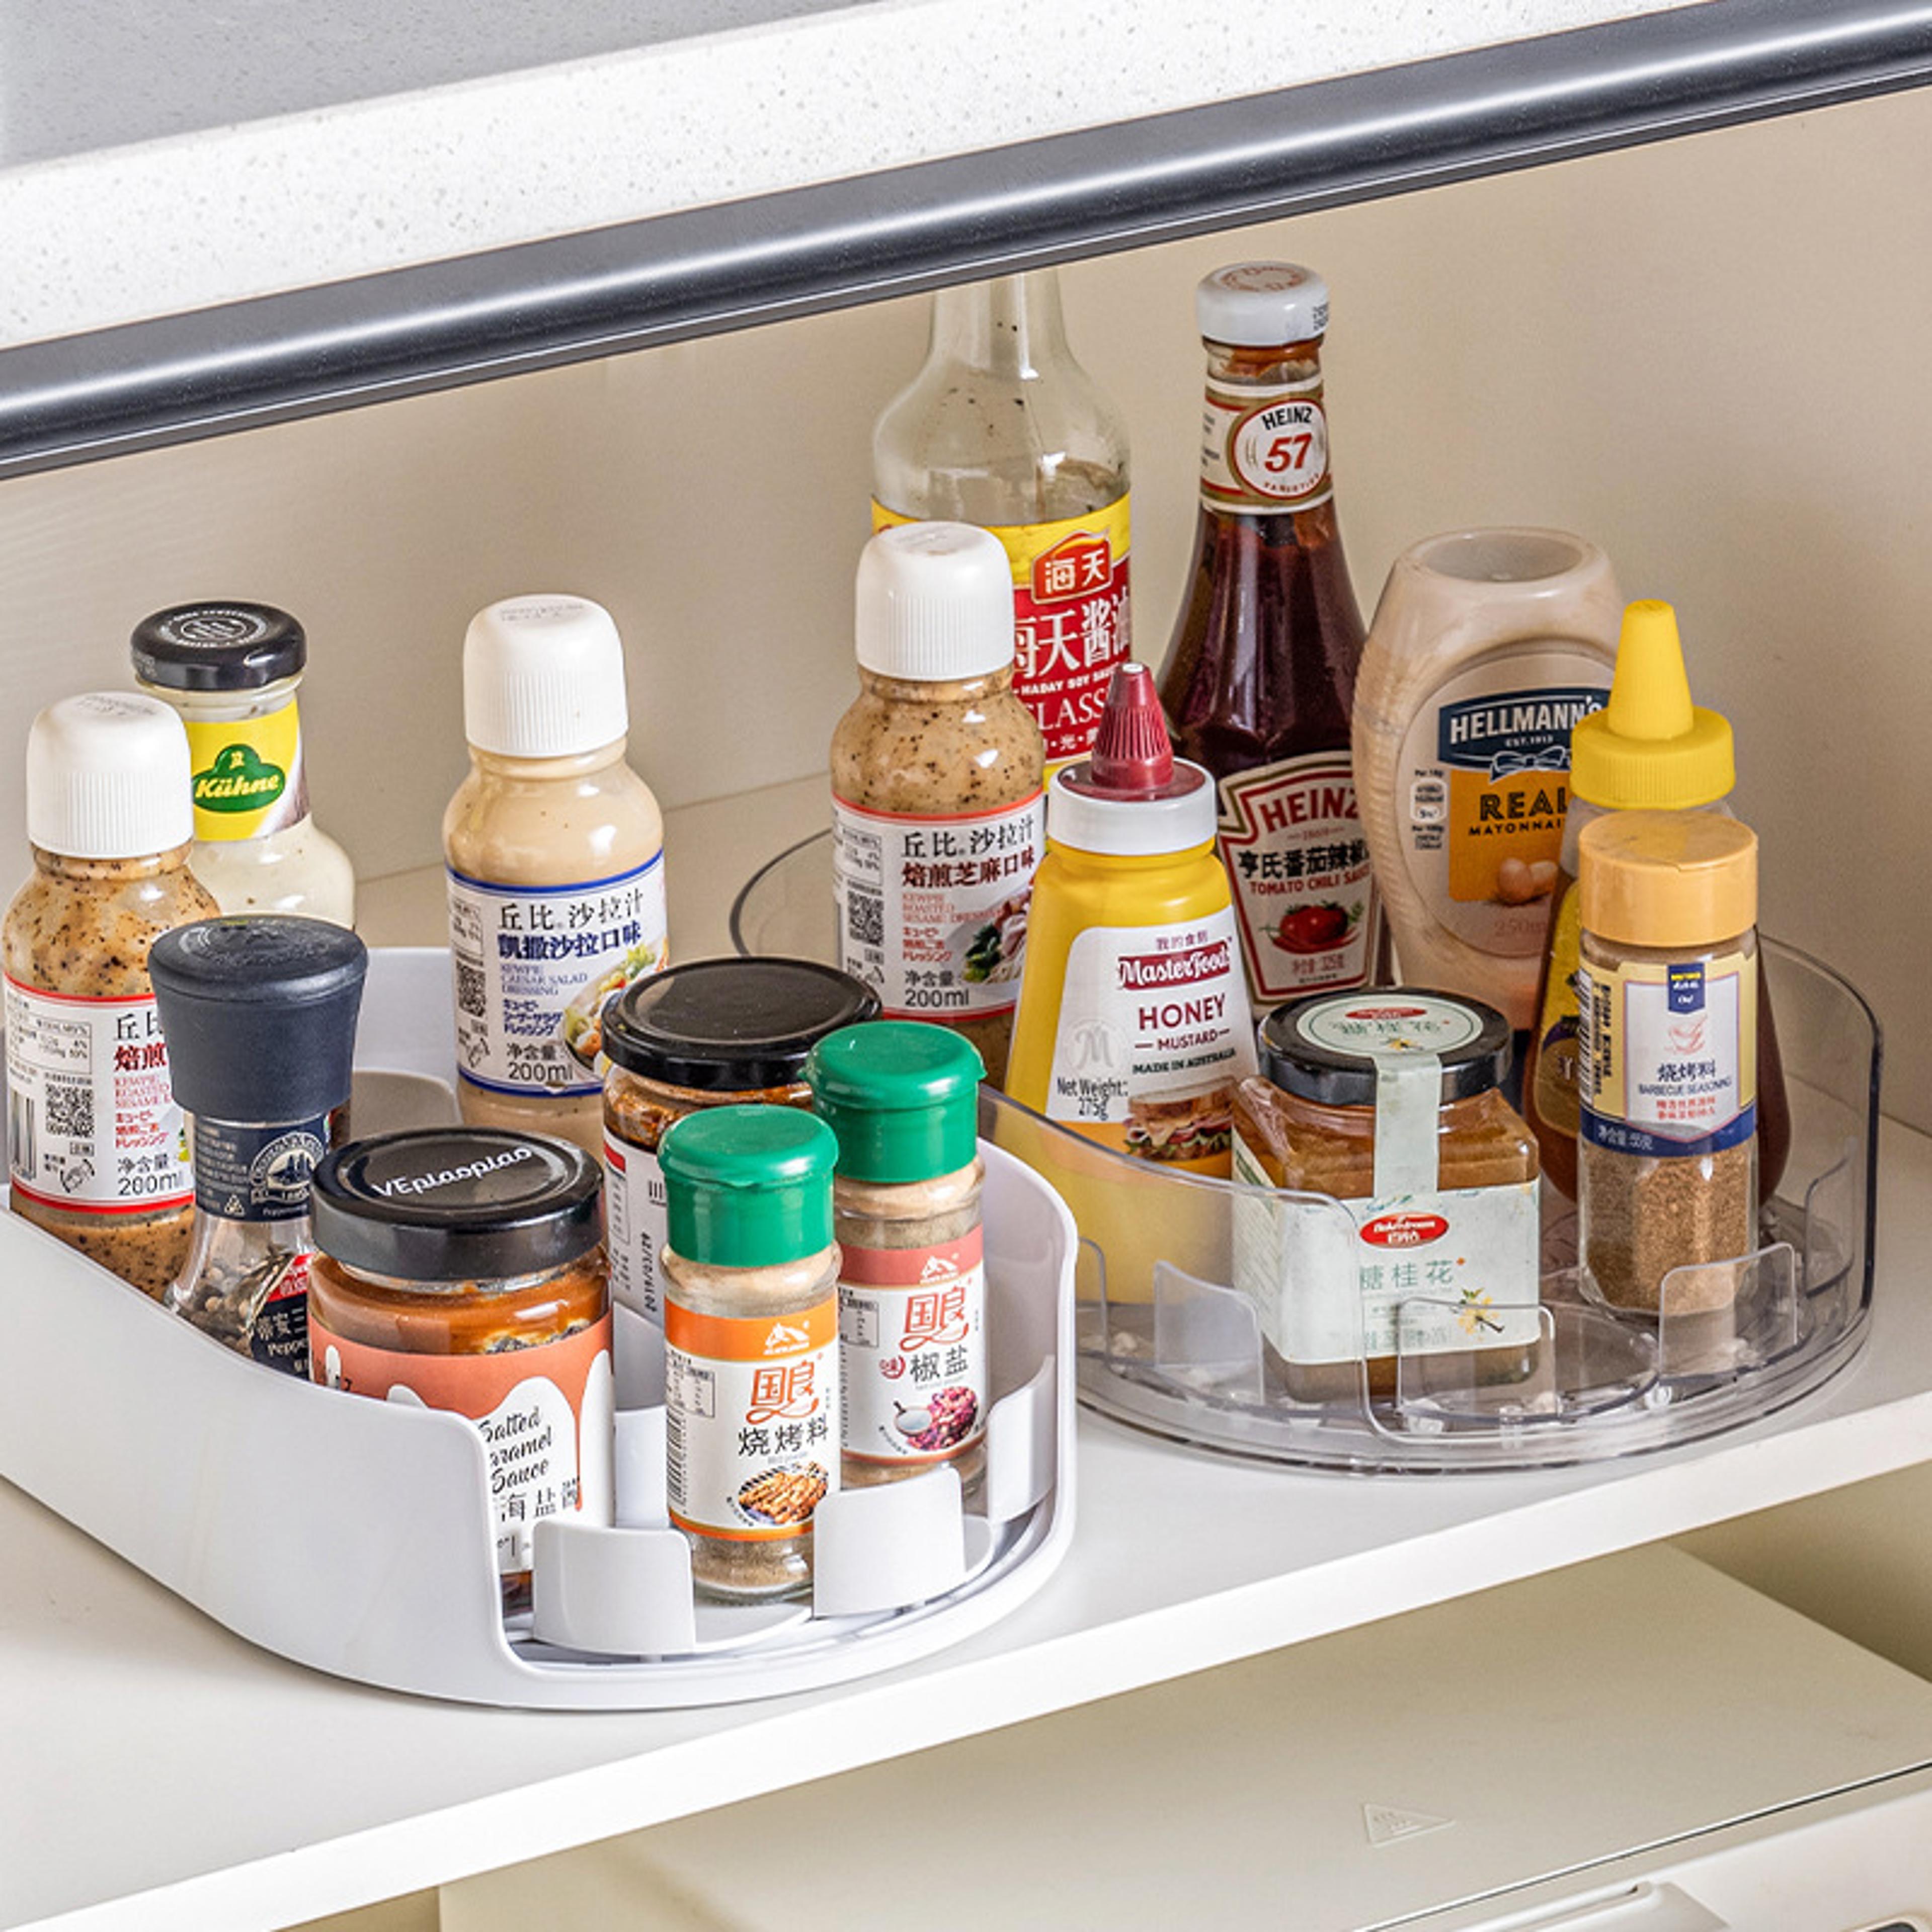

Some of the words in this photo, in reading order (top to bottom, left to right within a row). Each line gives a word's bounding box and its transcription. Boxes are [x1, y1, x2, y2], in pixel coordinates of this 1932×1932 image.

[1262, 406, 1313, 431] HEINZ
[1264, 432, 1313, 472] 57
[1045, 548, 1105, 594] 海天
[1021, 680, 1063, 695] HADAY
[1027, 687, 1106, 730] LASS
[195, 775, 280, 798] Kühne
[1258, 787, 1358, 833] HEINZ
[1480, 787, 1567, 822] REAL
[902, 846, 1034, 888] 焙煎芝麻口味
[1249, 880, 1304, 896] TOMATO
[498, 921, 641, 959] 凯撒沙拉口味
[905, 989, 969, 1007] 200ml
[1139, 993, 1225, 1030] HONEY
[1158, 1028, 1218, 1051] MUSTARD
[509, 1062, 574, 1082] 200ml
[1133, 1063, 1169, 1074] MADE
[1171, 1060, 1184, 1071] IN
[1658, 1060, 1716, 1083] 烧烤料
[1057, 1078, 1077, 1096] Net
[1078, 1097, 1109, 1121] 275g
[118, 1171, 185, 1196] 200ml
[1360, 1259, 1453, 1290] 糖桂花
[910, 1345, 968, 1383] 椒盐
[478, 1406, 541, 1443] Salted
[738, 1412, 829, 1457] 烧烤料
[491, 1459, 549, 1495] Sauce
